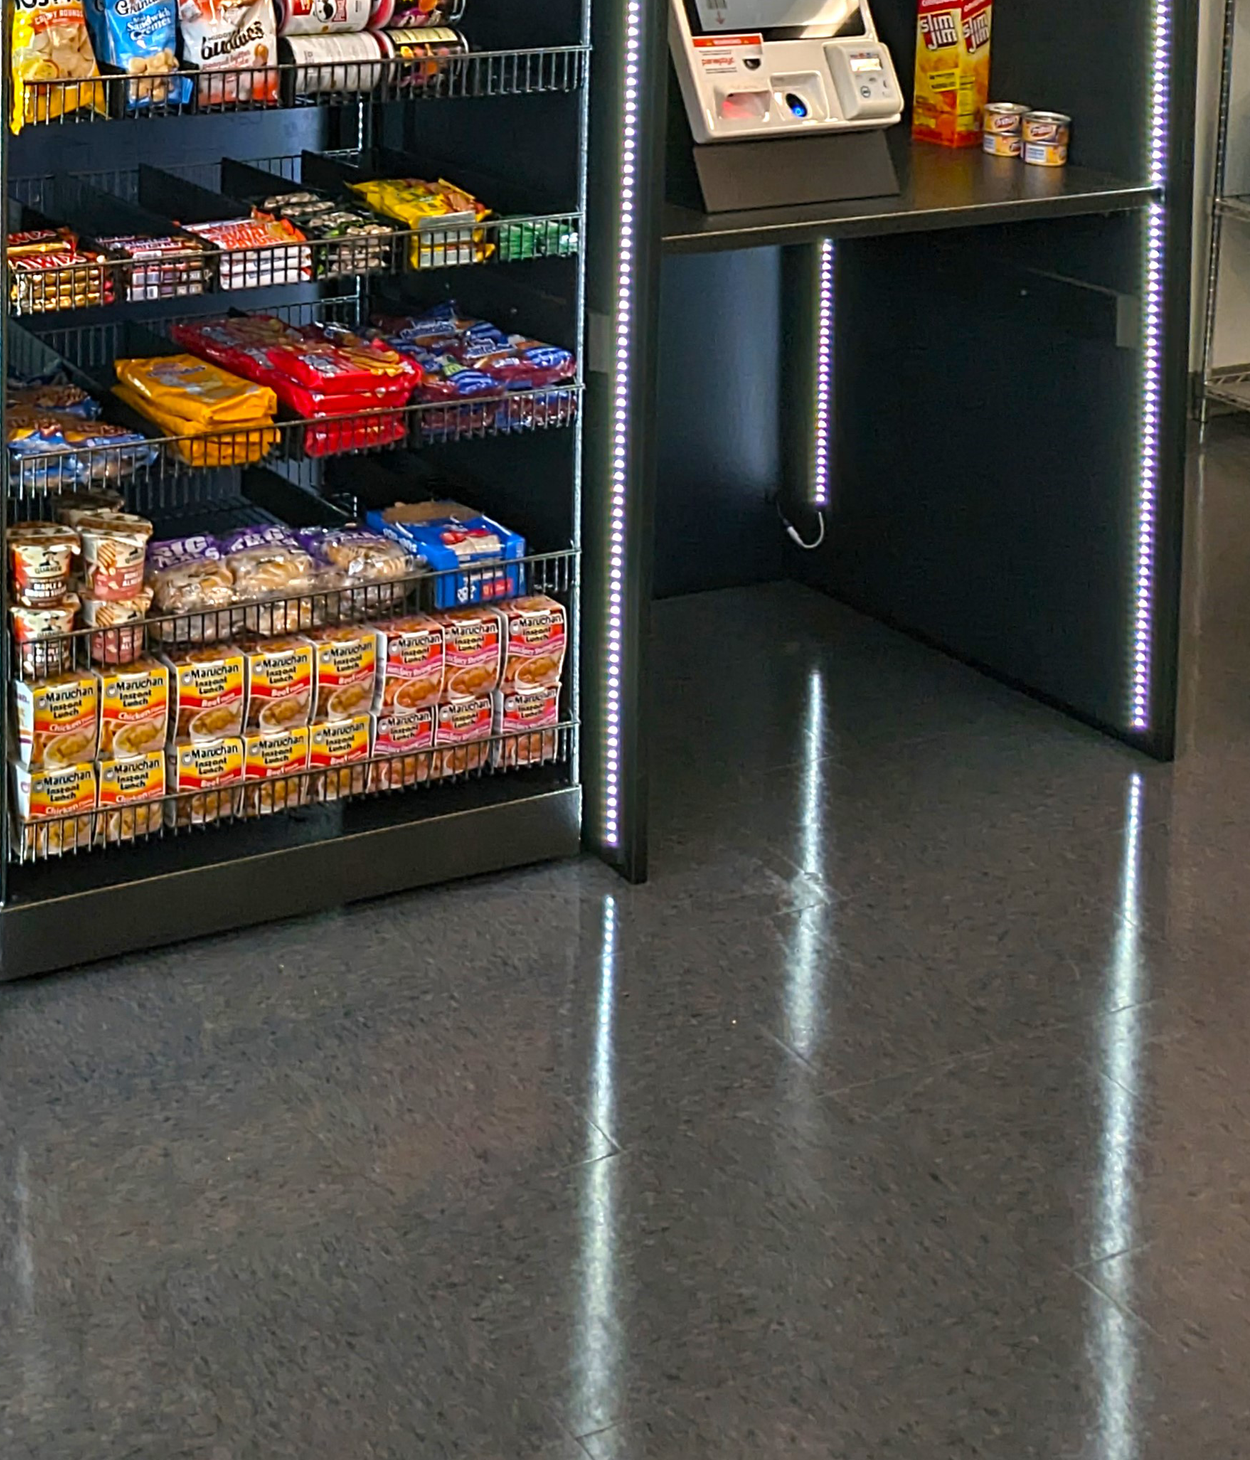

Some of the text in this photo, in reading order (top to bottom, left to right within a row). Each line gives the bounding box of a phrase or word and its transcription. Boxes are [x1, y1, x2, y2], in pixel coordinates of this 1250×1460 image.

[518, 614, 564, 628] Maruchan
[451, 623, 497, 638] Maruchan
[398, 634, 441, 648] Maruchan
[525, 633, 549, 642] Lunch
[331, 641, 373, 657] Maruchan
[458, 643, 482, 652] Lunch
[261, 653, 308, 671] Maruchan
[403, 655, 427, 663] Lunch
[190, 663, 239, 680] Maruchan
[336, 662, 360, 673] Lunch
[116, 676, 164, 692] Maruchan
[269, 674, 294, 684] Lunch
[45, 685, 94, 703] Maruchan
[198, 684, 225, 695] Lunch
[514, 688, 557, 704] Maruchan
[122, 697, 149, 708] Lunch
[447, 700, 491, 714] Maruchan
[53, 708, 80, 719] Lunch
[117, 709, 151, 722] Chicken
[520, 709, 544, 718] Lunch
[49, 718, 82, 732] Chicken
[386, 713, 431, 728] Maruchan
[453, 719, 476, 729] Lunch
[322, 722, 365, 738] Maruchan
[258, 734, 305, 750] Maruchan
[392, 733, 416, 742] Lunch
[190, 744, 238, 759] Maruchan
[328, 742, 352, 753] Lunch
[113, 758, 161, 774] Maruchan
[265, 755, 290, 766] Lunch
[198, 765, 224, 776] Lunch
[42, 769, 92, 787] Maruchan
[120, 780, 146, 791] Lunch
[49, 790, 77, 802] Lunch
[115, 792, 149, 804] Chicken
[45, 801, 78, 815] Chicken
